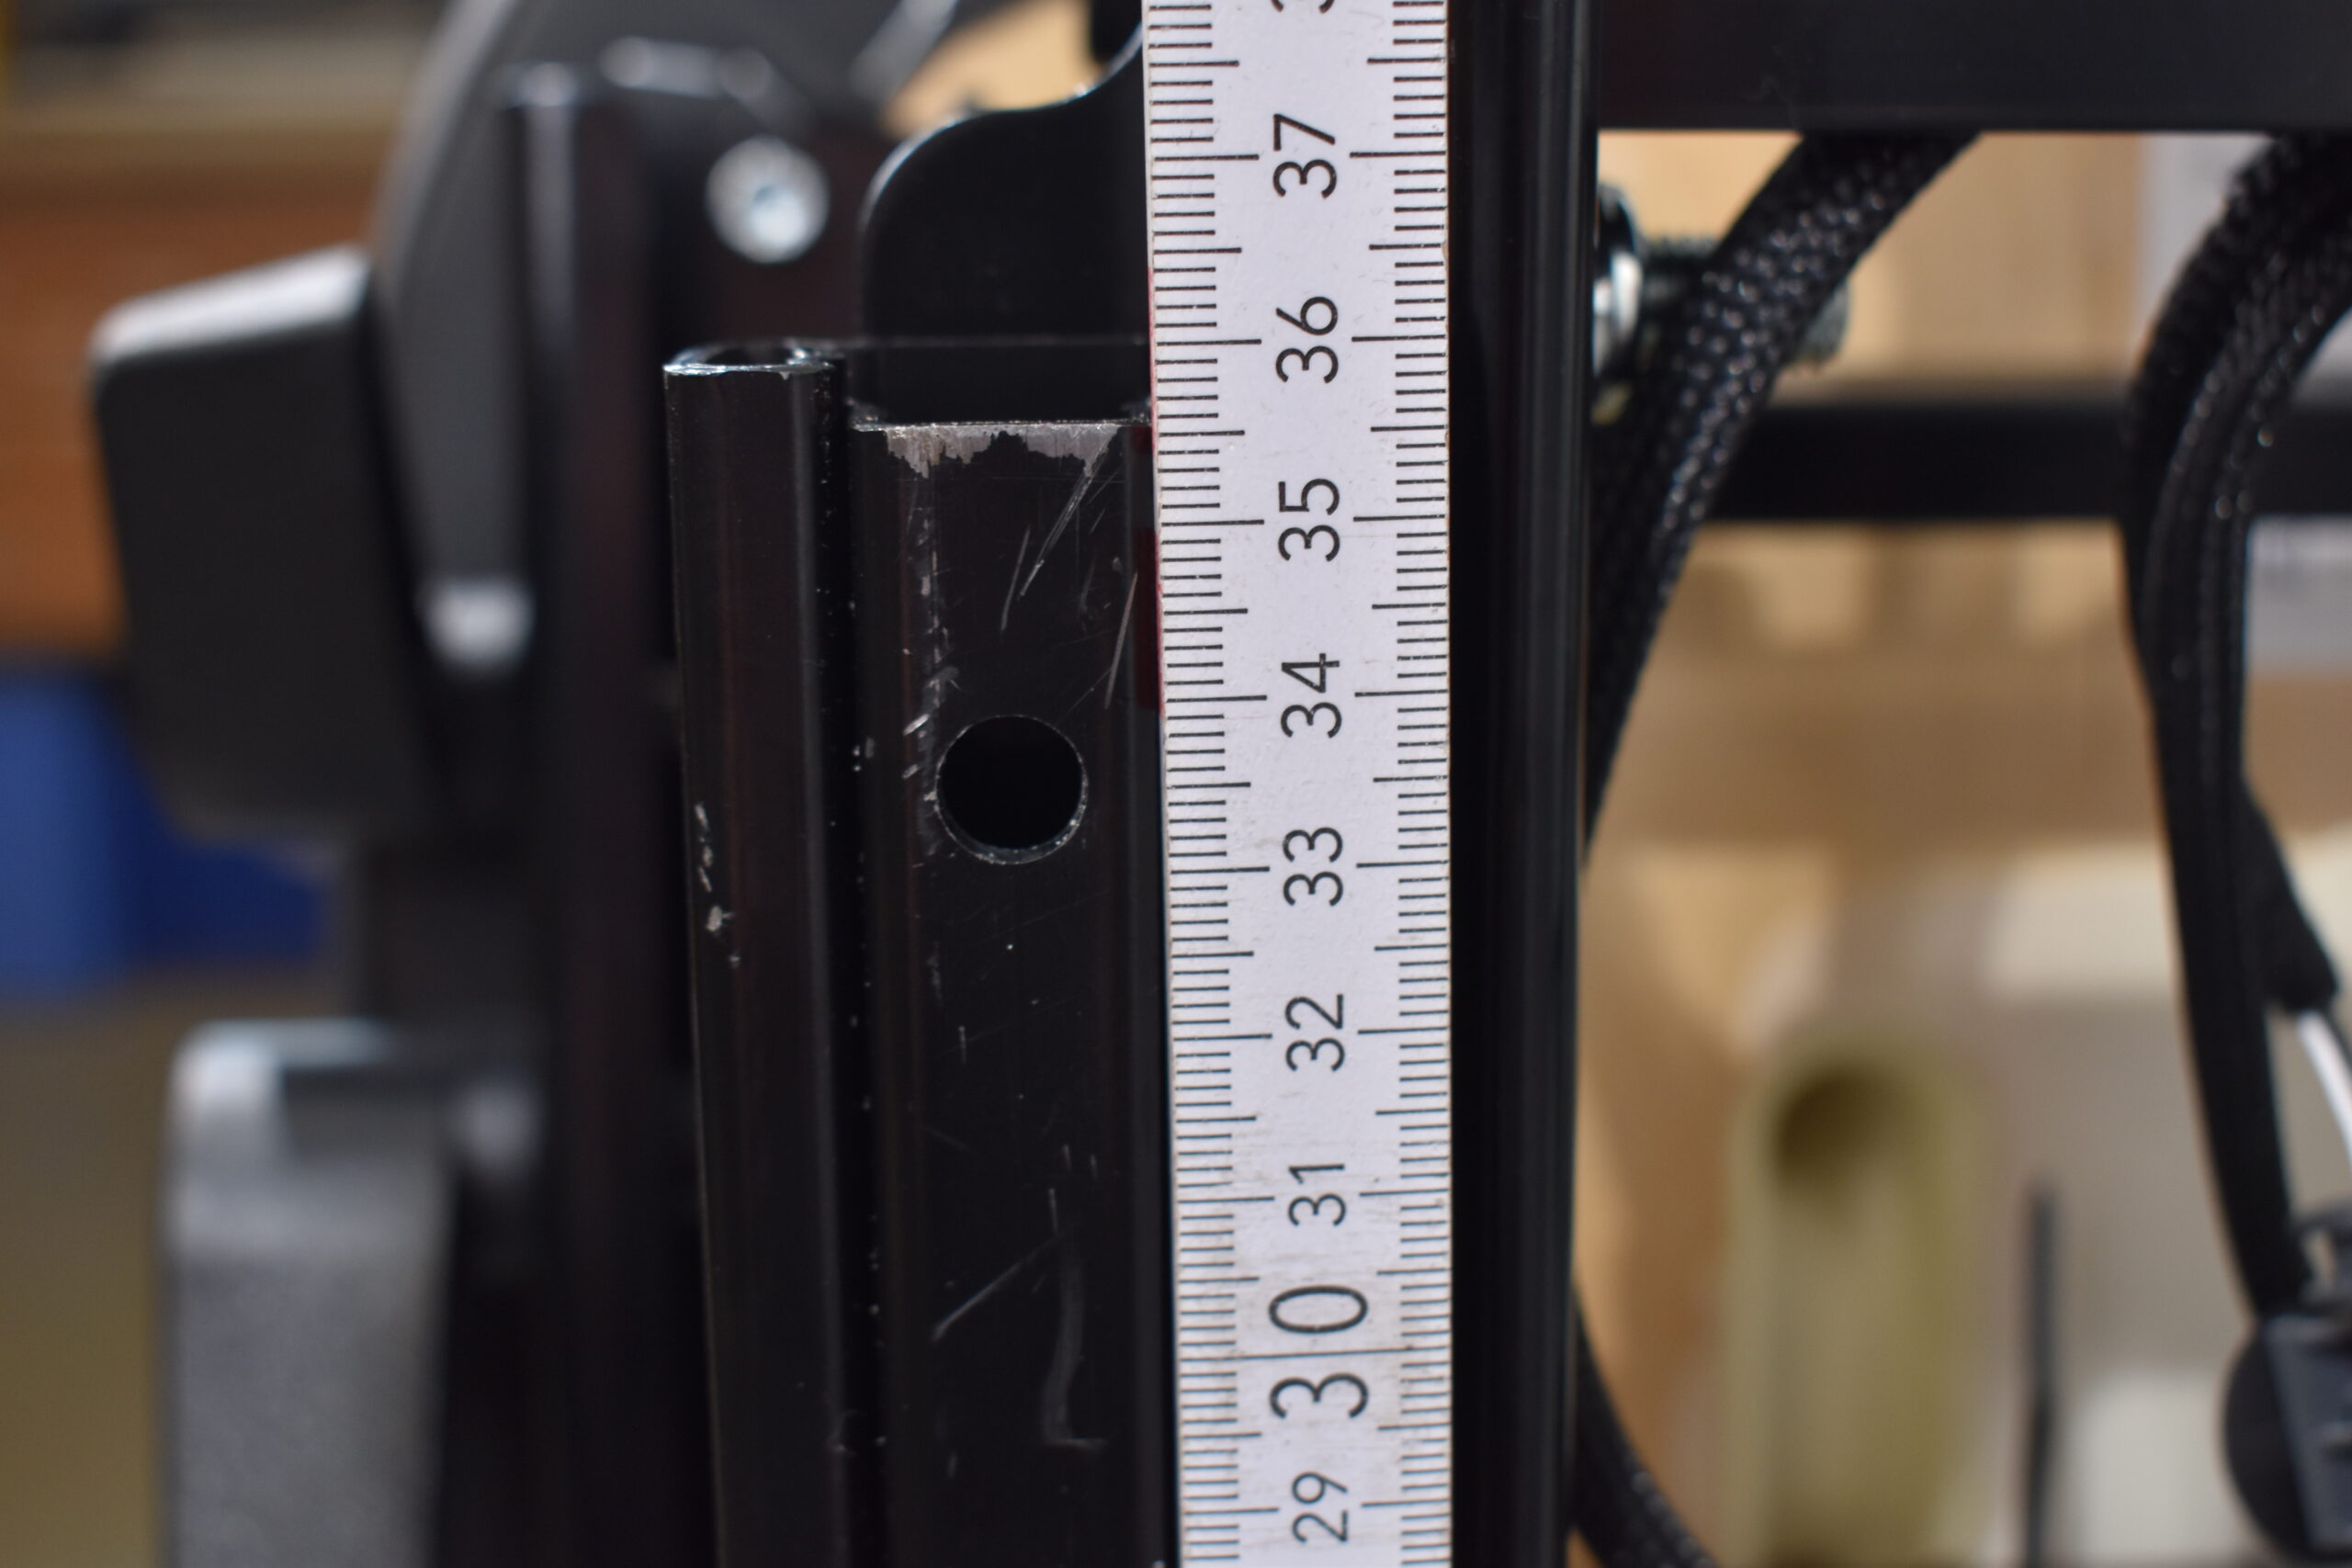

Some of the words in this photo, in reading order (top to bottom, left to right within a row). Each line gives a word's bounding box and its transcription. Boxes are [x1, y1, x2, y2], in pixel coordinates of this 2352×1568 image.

[1272, 112, 1338, 199] 37
[1275, 295, 1339, 385] 36
[1278, 477, 1340, 563] 35
[1280, 651, 1342, 739] 34
[1283, 826, 1344, 908] 33
[1284, 993, 1345, 1072] 32
[1287, 1162, 1347, 1226] 31
[1269, 1284, 1370, 1419] 30
[1291, 1472, 1348, 1543] 29
